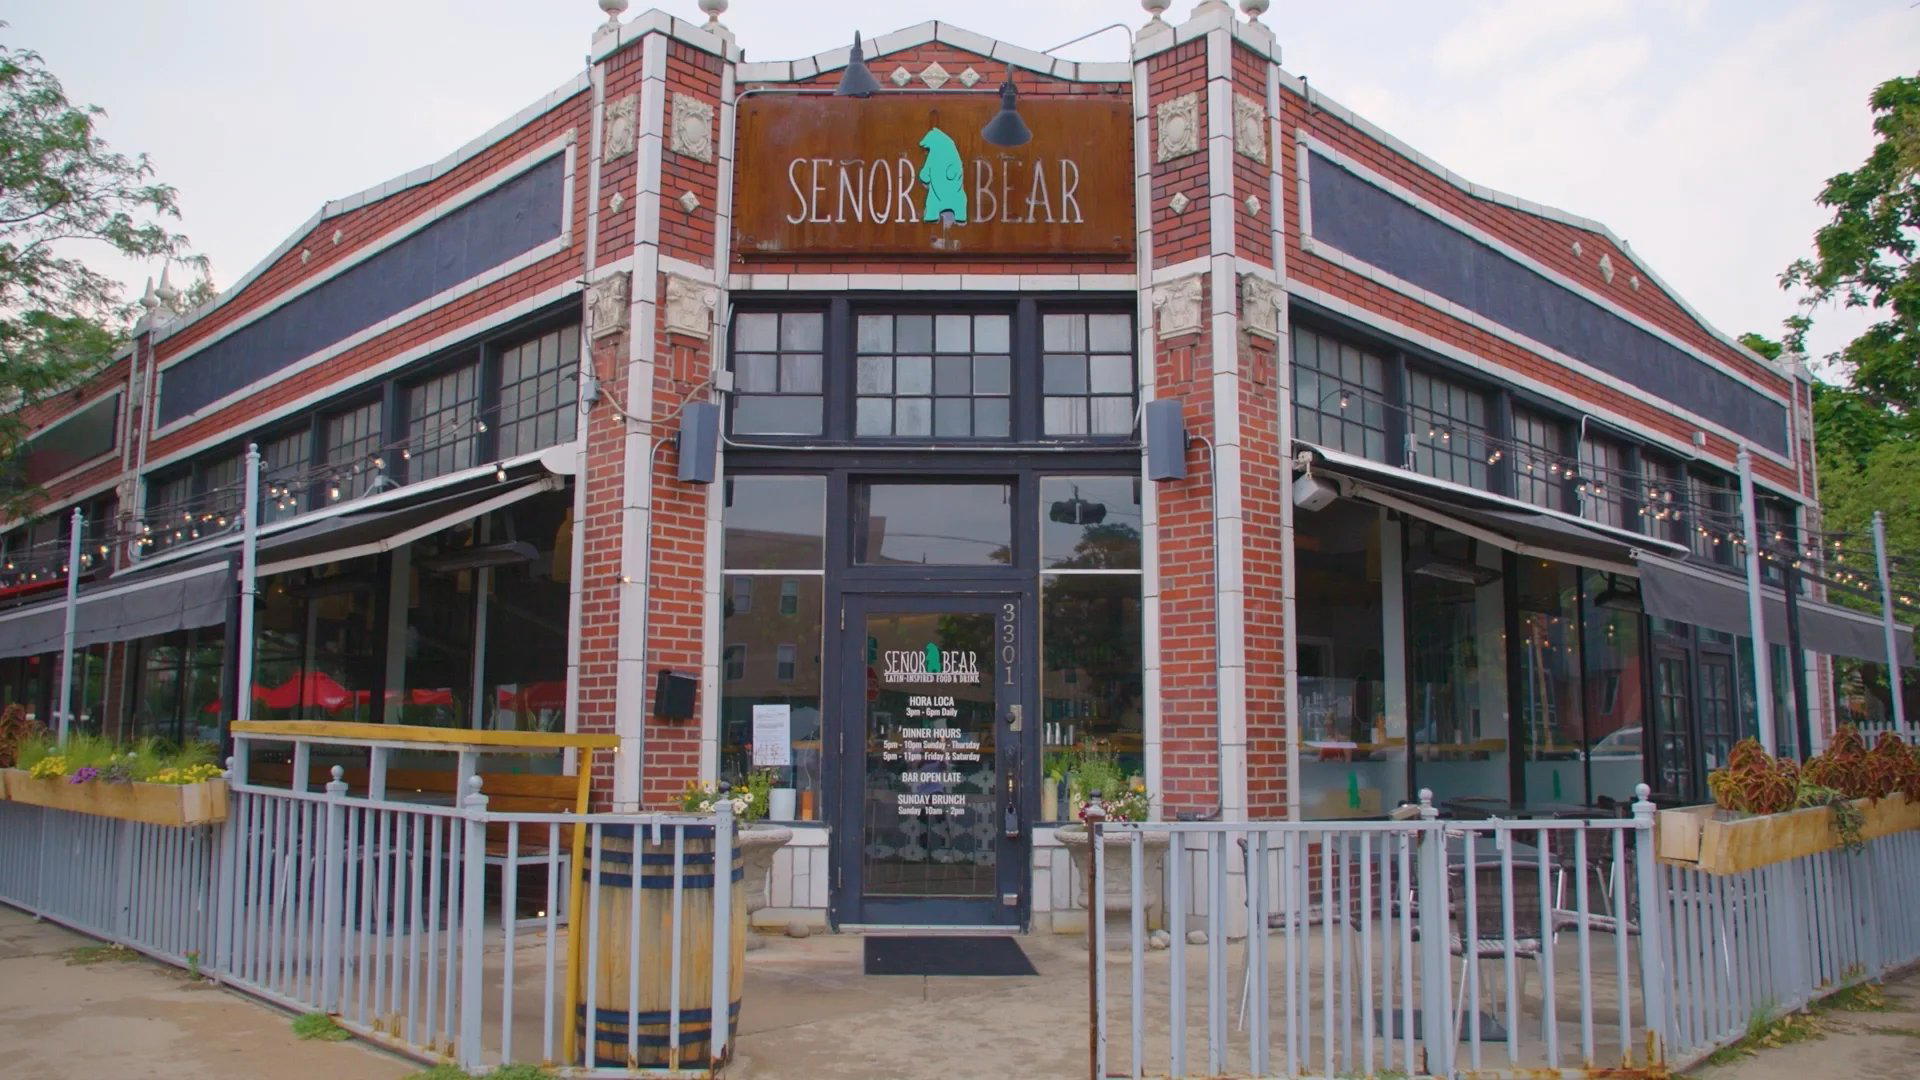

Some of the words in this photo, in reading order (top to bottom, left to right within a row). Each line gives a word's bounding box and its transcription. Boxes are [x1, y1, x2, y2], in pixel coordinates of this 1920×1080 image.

[786, 157, 920, 224] SEÑOR
[972, 157, 1084, 224] BEAR
[1003, 603, 1015, 685] 3301
[942, 650, 978, 674] BEAR
[936, 674, 951, 683] FOOD
[959, 674, 980, 683] DRINK
[909, 696, 932, 707] HORA
[933, 696, 955, 707] LOCA
[906, 707, 920, 717] 3pm
[925, 707, 940, 717] 6pm
[941, 707, 958, 717] Daily
[902, 728, 932, 738] DINNER
[933, 728, 962, 738] HOURS
[883, 740, 898, 750] 5pm
[904, 740, 922, 750] 10pm
[923, 740, 946, 750] Sunday
[952, 740, 980, 750] Thursday
[883, 752, 897, 761] 5pm
[904, 752, 921, 761] 11pm
[924, 752, 944, 761] Friday
[952, 752, 980, 762] Saturday
[902, 772, 919, 782] BAR
[920, 772, 941, 782] OPEN
[943, 772, 962, 782] LATE
[897, 794, 930, 805] SUNDAY
[931, 794, 966, 805] BRUNCH
[898, 806, 921, 816] Sunday
[925, 806, 943, 815] 10am
[950, 806, 965, 816] 2pm
